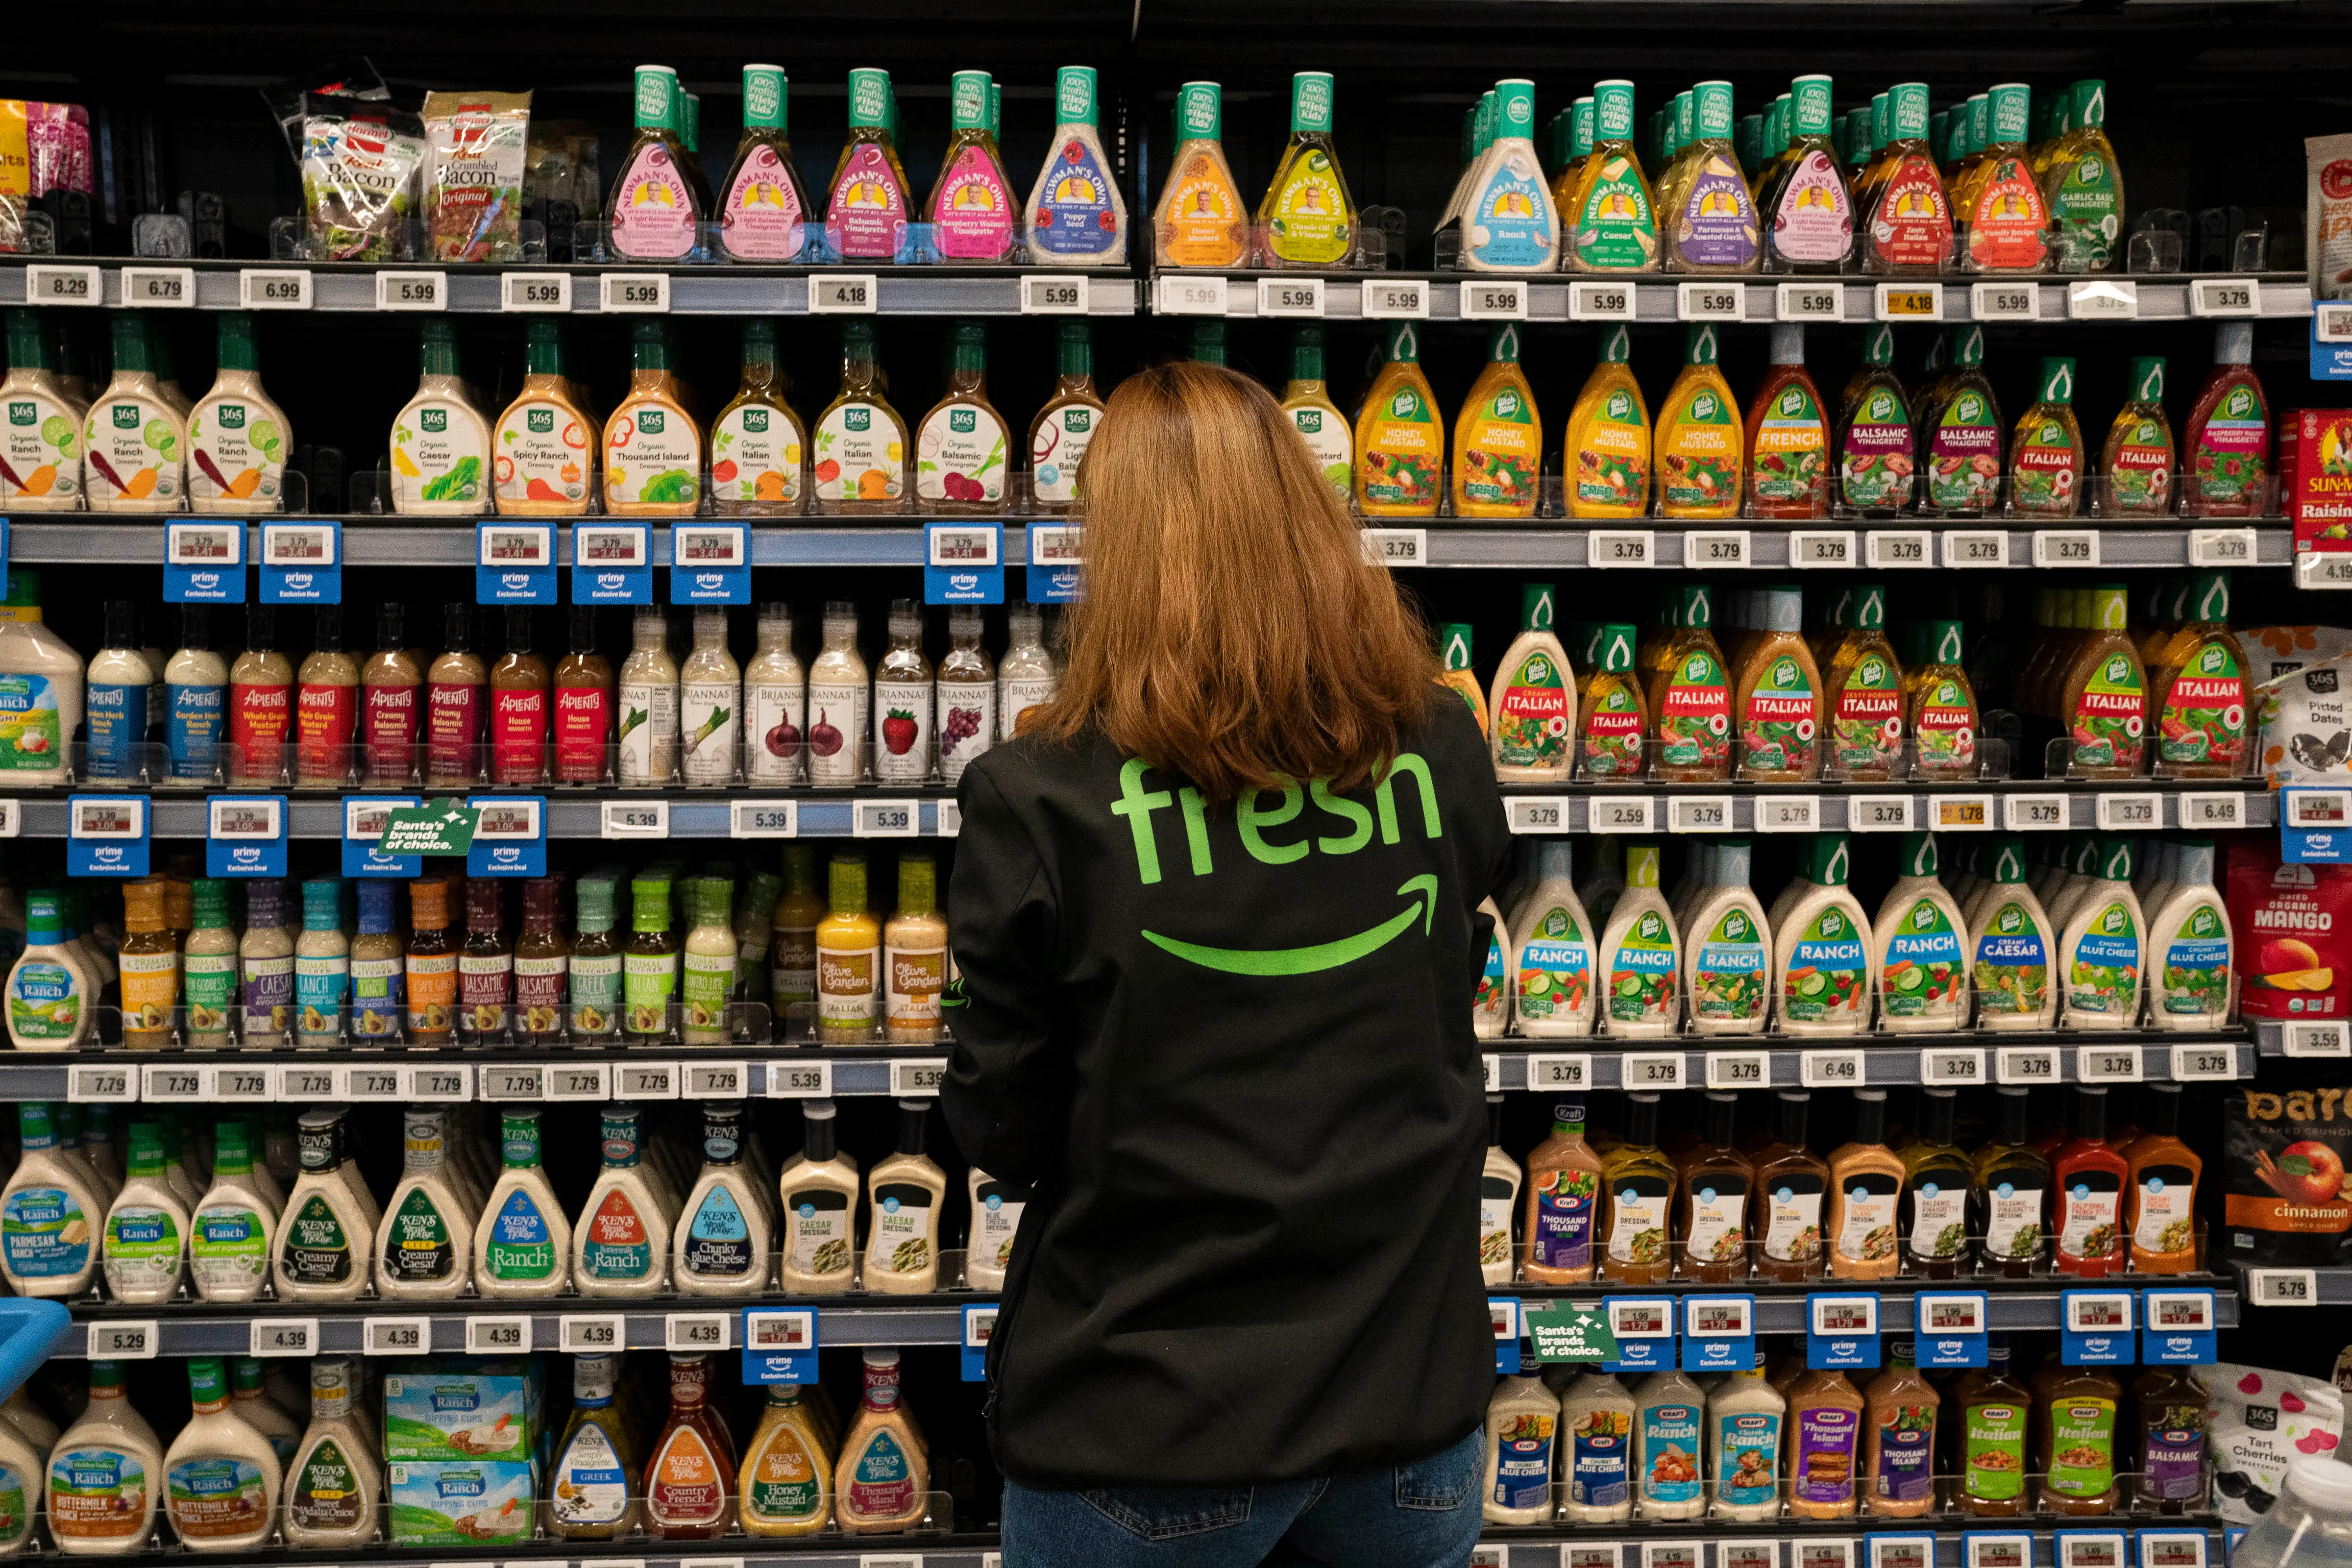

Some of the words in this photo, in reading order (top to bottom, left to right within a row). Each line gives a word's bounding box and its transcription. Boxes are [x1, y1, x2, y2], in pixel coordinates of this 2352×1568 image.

[451, 161, 498, 171] Crumbled
[1045, 165, 1093, 204] NEWMAN'S
[1090, 177, 1106, 205] OWN
[442, 192, 487, 205] Original
[1589, 182, 1634, 221] NEWMAN'S
[1634, 193, 1647, 221] OWN
[848, 217, 883, 226] Balsamic
[1064, 213, 1087, 222] Poppy
[1065, 220, 1084, 228] Seed
[844, 224, 888, 235] Vinaigrette
[1498, 230, 1526, 240] Ranch
[1602, 231, 1633, 241] Caesar
[54, 279, 88, 294] 8.29
[149, 281, 182, 296] 6.79
[265, 283, 299, 298] 6.99
[527, 287, 560, 301] 5.99
[625, 287, 658, 302] 5.99
[836, 288, 866, 302] 4.18
[1046, 289, 1078, 303] 5.99
[1282, 292, 1314, 306] 5.99
[1387, 293, 1418, 307] 5.99
[2219, 292, 2249, 305] 3.79
[1594, 295, 1625, 309] 5.99
[1906, 296, 1933, 310] 4.18
[1998, 296, 2029, 310] 5.99
[1495, 392, 1515, 407] Wish
[114, 409, 137, 420] 365
[1496, 404, 1516, 416] Bone
[423, 413, 444, 424] 365
[746, 413, 766, 423] 365
[1386, 428, 1421, 439] HONEY
[1760, 432, 1821, 446] FRENCH
[1853, 427, 1907, 439] BALSAMIC
[113, 437, 141, 447] Organic
[420, 441, 448, 450] Organic
[526, 441, 554, 450] Organic
[742, 440, 770, 449] Organic
[1380, 436, 1425, 447] MUSTARD
[114, 447, 143, 456] Ranch
[419, 451, 450, 460] Caesar
[514, 451, 539, 462] Spicy
[541, 452, 569, 460] Ranch
[616, 452, 659, 461] Thousand
[662, 452, 689, 461] Island
[742, 450, 770, 460] Italian
[942, 451, 981, 461] Balsamic
[2024, 453, 2071, 465] ITALIAN
[1387, 542, 1416, 557] 3.79
[1615, 543, 1644, 558] 3.79
[1711, 543, 1740, 558] 3.79
[1892, 543, 1921, 558] 3.79
[2060, 543, 2089, 558] 3.79
[502, 573, 529, 585] prime
[370, 689, 412, 707] APLENTY
[877, 689, 925, 700] BRIANNAS
[1669, 692, 1723, 704] ITALIAN
[500, 694, 540, 711] APLENTY
[1508, 697, 1563, 710] ITALIAN
[1756, 700, 1811, 713] ITALIAN
[1843, 699, 1897, 712] ITALIAN
[2309, 702, 2343, 713] Pitted
[509, 716, 531, 725] House
[1593, 716, 1638, 727] ITALIAN
[2311, 713, 2343, 724] Dates
[1530, 809, 1559, 823] 3.79
[1614, 808, 1643, 823] 2.59
[1694, 808, 1722, 822] 3.79
[1875, 807, 1903, 821] 3.79
[1960, 807, 1984, 820] 1.78
[2031, 807, 2059, 820] 3.79
[2124, 806, 2152, 819] 3.79
[2205, 805, 2234, 818] 6.49
[756, 813, 785, 827] 5.39
[878, 812, 908, 826] 5.39
[393, 821, 444, 831] Santa's
[389, 830, 439, 840] brands
[386, 840, 406, 850] of
[408, 840, 452, 849] choice.
[2269, 901, 2318, 911] ORGANIC
[2254, 910, 2332, 930] MANGO
[1896, 936, 1954, 953] RANCH
[1984, 945, 2037, 956] CAESAR
[1529, 949, 1582, 964] RANCH
[1801, 945, 1859, 959] RANCH
[2081, 945, 2107, 956] BLUE
[2108, 948, 2136, 958] CHEESE
[1621, 952, 1671, 966] RANCH
[1706, 954, 1759, 967] RANCH
[822, 963, 852, 976] Olive
[465, 976, 503, 992] BALSAMIC
[825, 974, 869, 989] Garden
[2310, 1033, 2339, 1047] 3.59
[1825, 1062, 1855, 1076] 6.49
[2022, 1060, 2050, 1073] 3.79
[2105, 1058, 2132, 1072] 3.79
[1553, 1066, 1581, 1080] 3.79
[1648, 1065, 1675, 1079] 3.79
[96, 1078, 125, 1092] 7.79
[169, 1078, 198, 1092] 7.79
[301, 1078, 331, 1092] 7.79
[431, 1078, 460, 1091] 7.79
[570, 1078, 599, 1091] 7.79
[709, 1074, 735, 1087] 7.79
[791, 1073, 821, 1087] 5.39
[23, 1209, 59, 1221] Ranch
[2275, 1203, 2348, 1218] cinnamon
[502, 1215, 538, 1226] KEN'S
[800, 1220, 832, 1229] CAESAR
[1542, 1215, 1587, 1225] THOUSAND
[1549, 1223, 1580, 1232] ISLAND
[10, 1236, 55, 1248] PARMESAN
[699, 1242, 737, 1255] Chunky
[495, 1248, 548, 1267] Ranch
[691, 1253, 711, 1263] Blue
[712, 1253, 746, 1265] Cheese
[2278, 1283, 2306, 1295] 5.79
[584, 1328, 613, 1342] 4.39
[689, 1326, 719, 1340] 4.39
[1536, 1325, 1585, 1335] Santa's
[114, 1335, 145, 1348] 5.29
[276, 1332, 306, 1346] 4.39
[388, 1331, 418, 1345] 4.39
[1538, 1336, 1585, 1346] brands
[1541, 1346, 1561, 1355] of
[1562, 1346, 1604, 1355] choice.
[767, 1356, 792, 1367] prime
[2250, 1409, 2274, 1421] 365
[1648, 1425, 1697, 1439] Ranch
[1803, 1422, 1853, 1433] Thousand
[1971, 1427, 2021, 1441] Italian
[1813, 1432, 1844, 1443] Island
[2248, 1436, 2273, 1449] Tart
[2148, 1450, 2198, 1462] BALSAMIC
[2233, 1446, 2287, 1464] Cherries
[1576, 1463, 1597, 1472] BLUE
[1598, 1463, 1624, 1472] CHEESE
[74, 1472, 114, 1484] Ranch
[580, 1472, 612, 1481] GREEK
[768, 1484, 802, 1497] Honey
[431, 1500, 461, 1509] DIPPING
[463, 1499, 488, 1508] CUPS
[764, 1494, 806, 1505] Mustard
